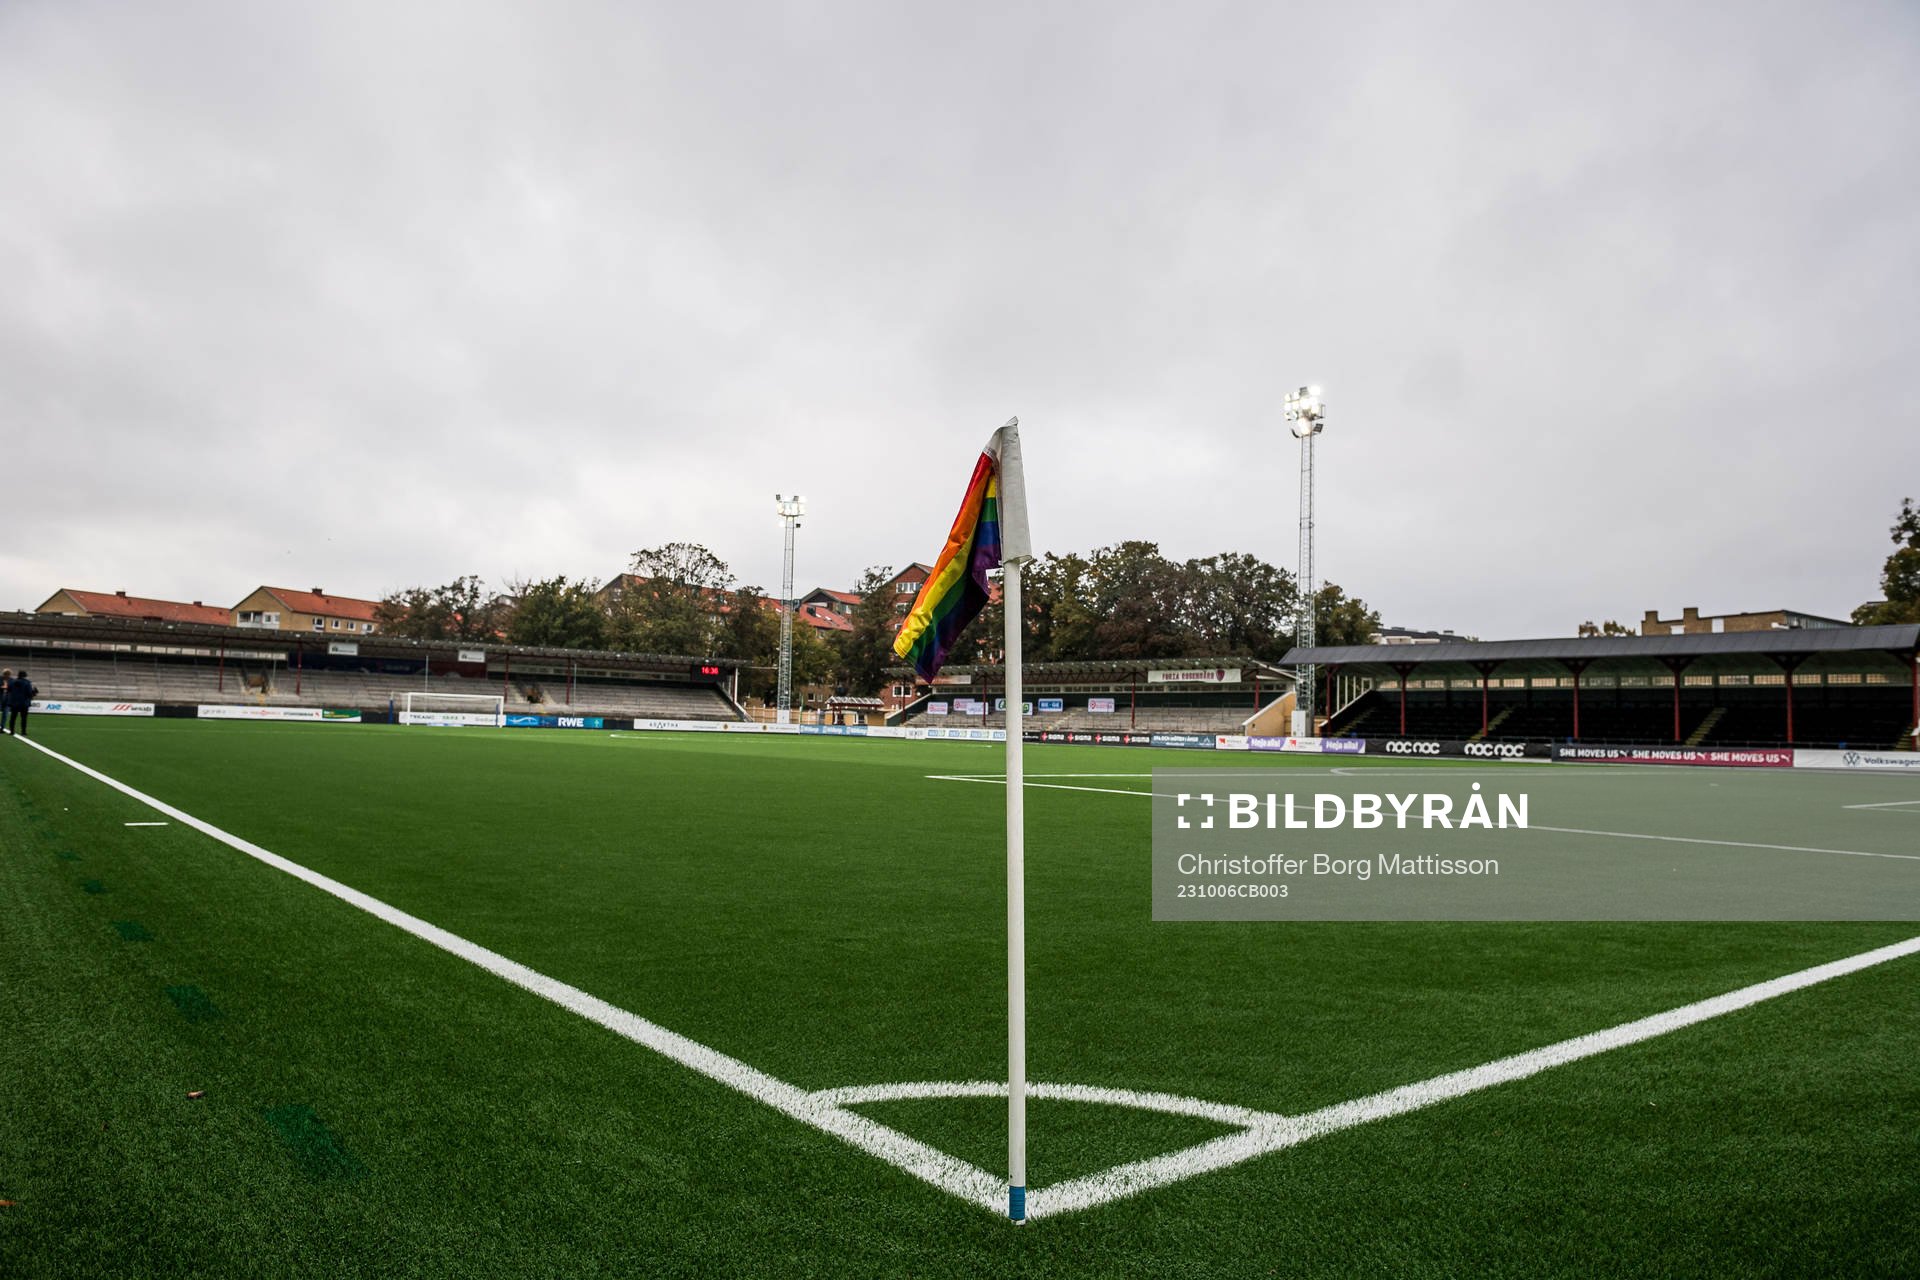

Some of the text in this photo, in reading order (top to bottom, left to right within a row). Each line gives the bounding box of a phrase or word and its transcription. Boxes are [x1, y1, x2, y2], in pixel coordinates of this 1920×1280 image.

[558, 717, 584, 727] RWE
[1559, 748, 1619, 758] SHE MOVES US
[1632, 750, 1696, 760] SHE MOVES US
[1711, 752, 1780, 763] SHE MOVES US
